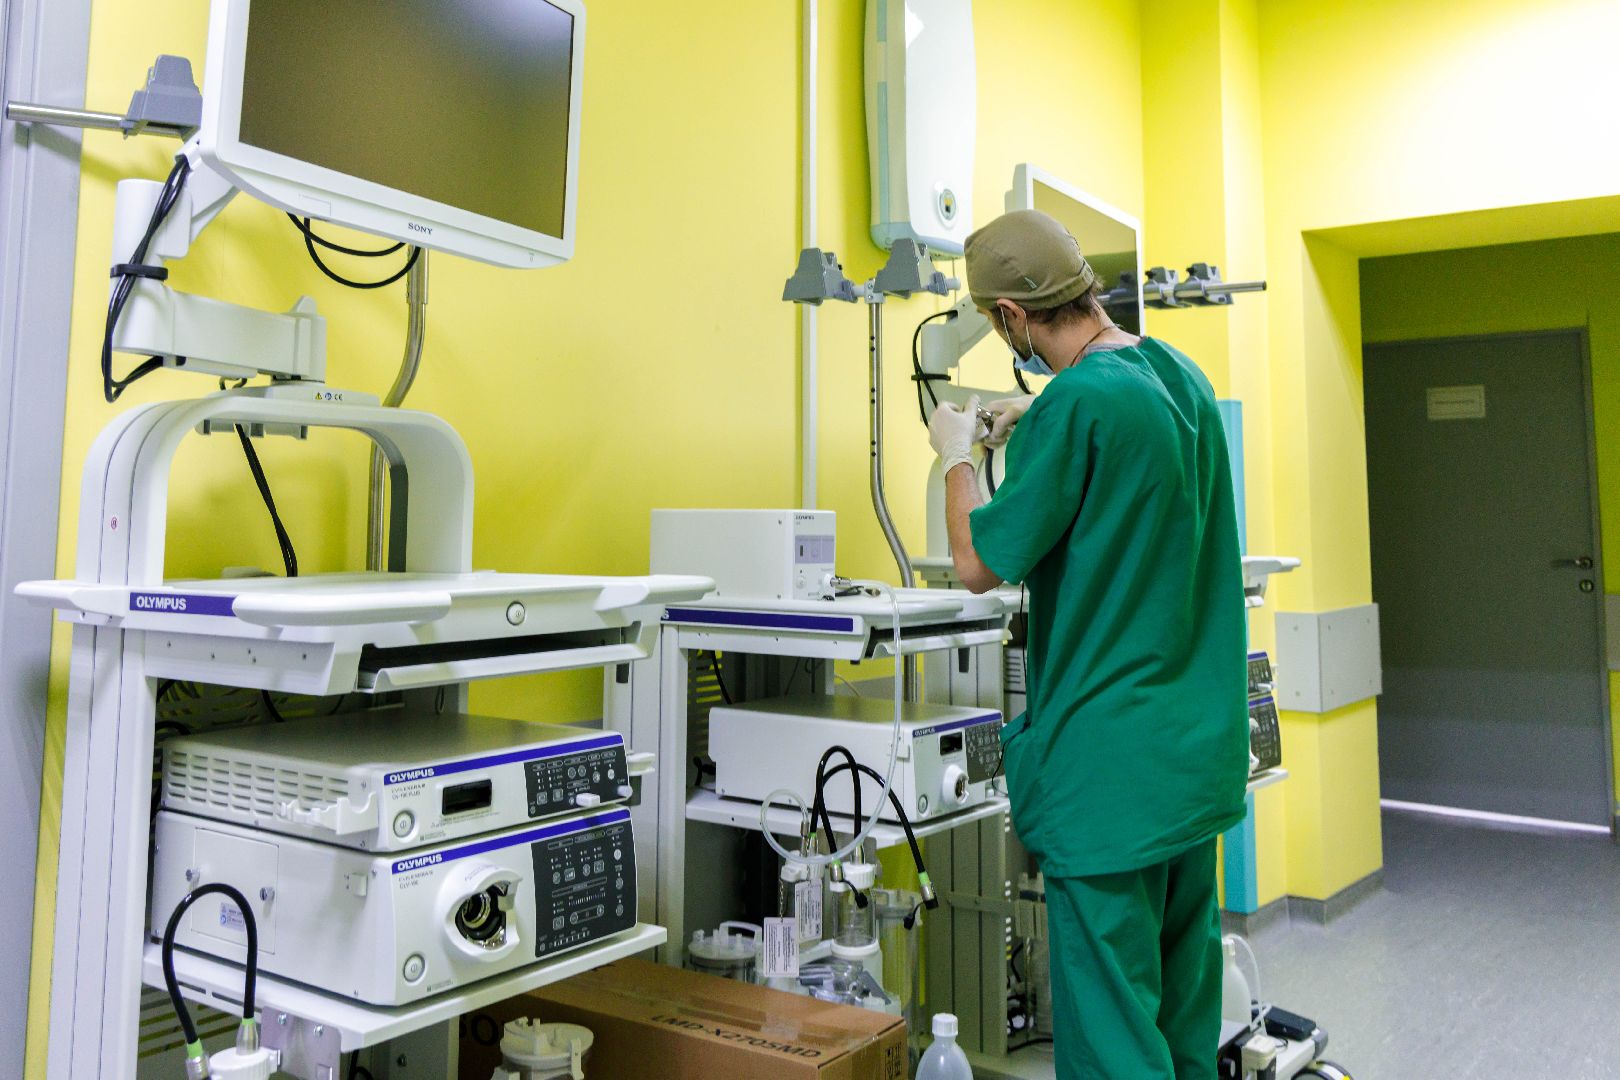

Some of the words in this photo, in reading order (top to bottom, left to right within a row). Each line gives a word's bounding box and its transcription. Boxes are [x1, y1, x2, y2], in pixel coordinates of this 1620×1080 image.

[408, 222, 433, 235] SONY
[136, 595, 187, 611] OLYMPUS
[389, 768, 434, 783] OLYMPUS
[398, 854, 442, 871] OLYMPUS
